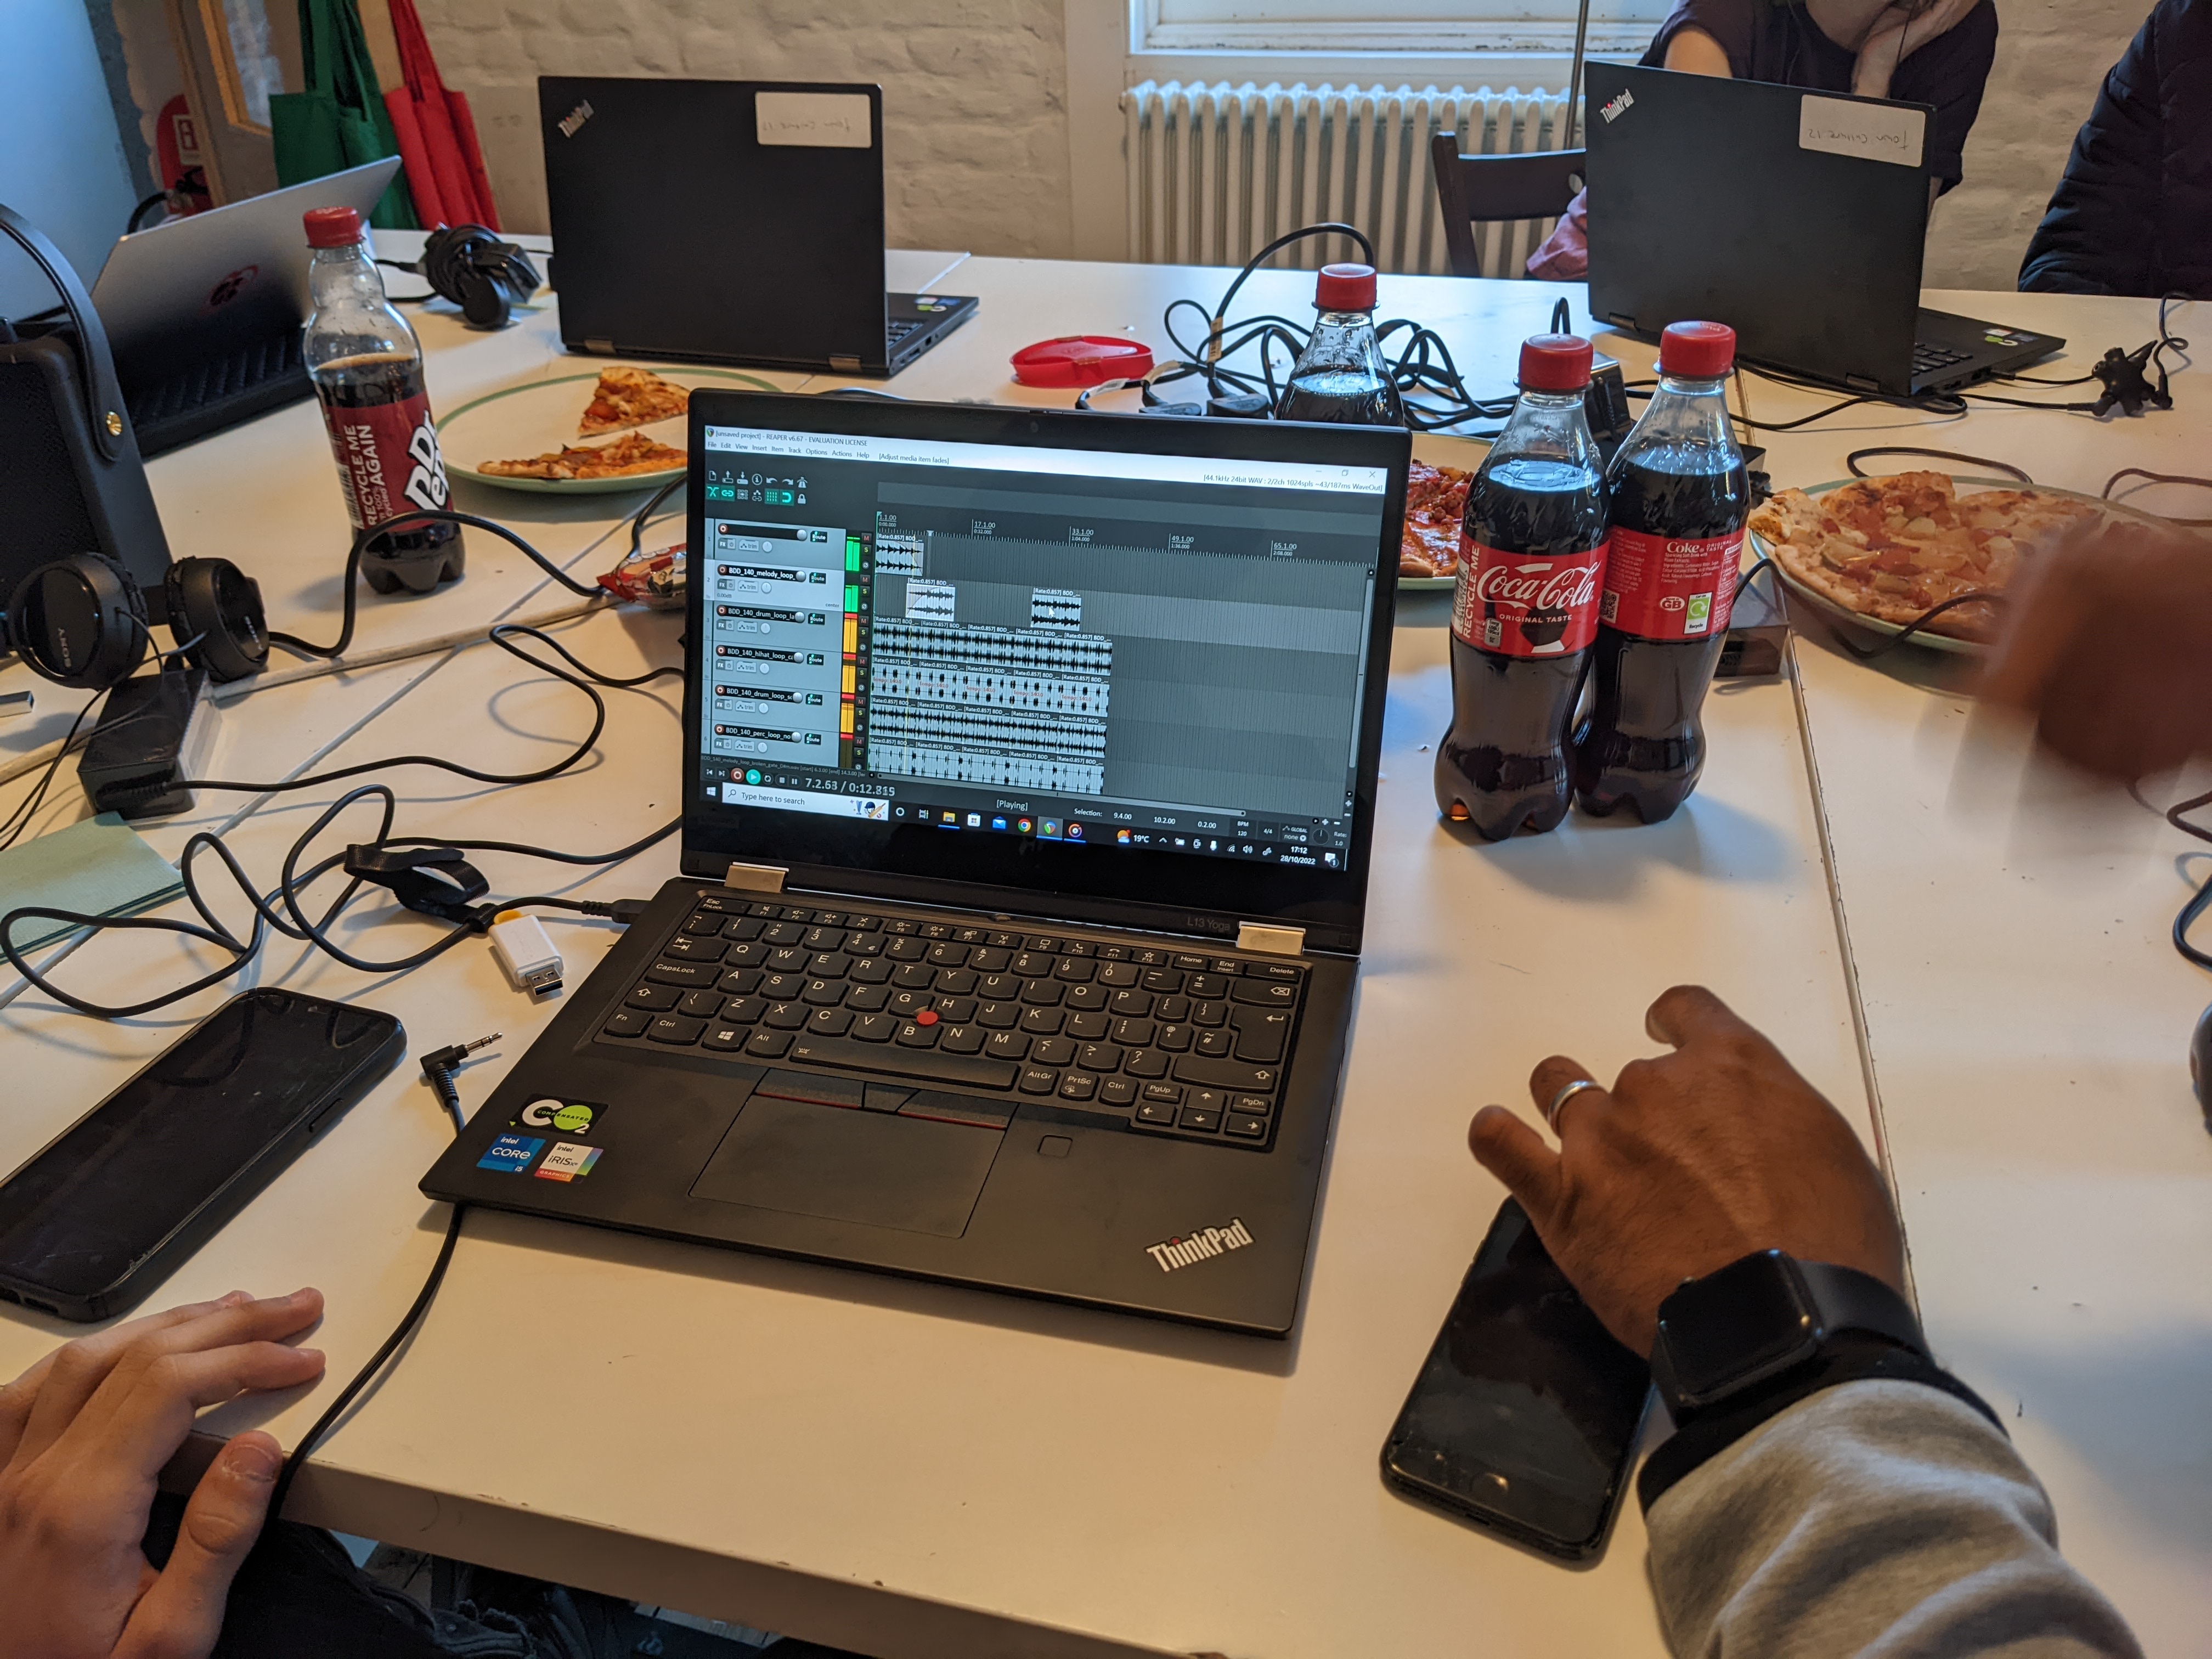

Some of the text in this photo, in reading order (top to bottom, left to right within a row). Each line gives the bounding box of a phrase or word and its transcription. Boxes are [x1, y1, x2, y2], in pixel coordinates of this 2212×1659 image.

[1600, 88, 1634, 123] ThinkPad
[1876, 130, 1909, 150] Town
[809, 437, 844, 445] EVALUATION
[357, 425, 386, 486] AGAIN
[343, 425, 377, 526] RECYCLE ME
[1353, 483, 1383, 492] WaveOut]
[1171, 535, 1194, 543] 49.1.00
[1667, 541, 1700, 554] Coke
[1477, 560, 1602, 610] Coca-Cola
[1463, 545, 1480, 638] RECYCLE ME
[1662, 600, 1681, 609] GB
[1499, 613, 1573, 623] ORIGINAL TASTE
[741, 792, 757, 800] Type
[758, 793, 773, 802] here
[783, 797, 805, 805] search
[996, 799, 1216, 829] [Playing] Selection: 9.4.00 10.2.00 0.2.00
[1290, 846, 1308, 854] 17:12
[1280, 855, 1316, 865] 28/10/2022
[1187, 917, 1231, 932] L13 Yoga
[736, 945, 748, 953] Q
[778, 950, 793, 958] W
[1180, 955, 1202, 963] Home
[656, 963, 696, 974] CapsLock
[859, 961, 871, 969] R
[947, 971, 956, 979] Y
[1269, 967, 1294, 975] Delete
[771, 975, 782, 984] S
[988, 977, 998, 985] U
[812, 981, 824, 990] D
[1030, 981, 1036, 990] I
[1075, 987, 1087, 995] O
[899, 994, 911, 1002] G
[1118, 992, 1129, 1000] P
[731, 999, 744, 1007] Z
[941, 999, 955, 1008] H
[774, 1005, 787, 1013] X
[986, 1005, 995, 1013] J
[1029, 1009, 1041, 1018] K
[819, 1011, 831, 1019] C
[1074, 1014, 1083, 1023] L
[864, 1017, 875, 1025] V
[904, 1026, 915, 1035] B
[950, 1029, 963, 1037] N
[995, 1034, 1009, 1043] M
[1028, 1070, 1052, 1080] AltGr
[1066, 1075, 1091, 1085] PrtSc
[1108, 1081, 1125, 1090] Ctrl
[1150, 1085, 1171, 1094] PgUp
[1243, 1098, 1265, 1107] PgDn
[537, 1110, 589, 1122] COMPENSATED
[500, 1136, 520, 1144] intel
[540, 1170, 570, 1178] GRAPHICS
[1147, 1218, 1254, 1272] ThinkPad
